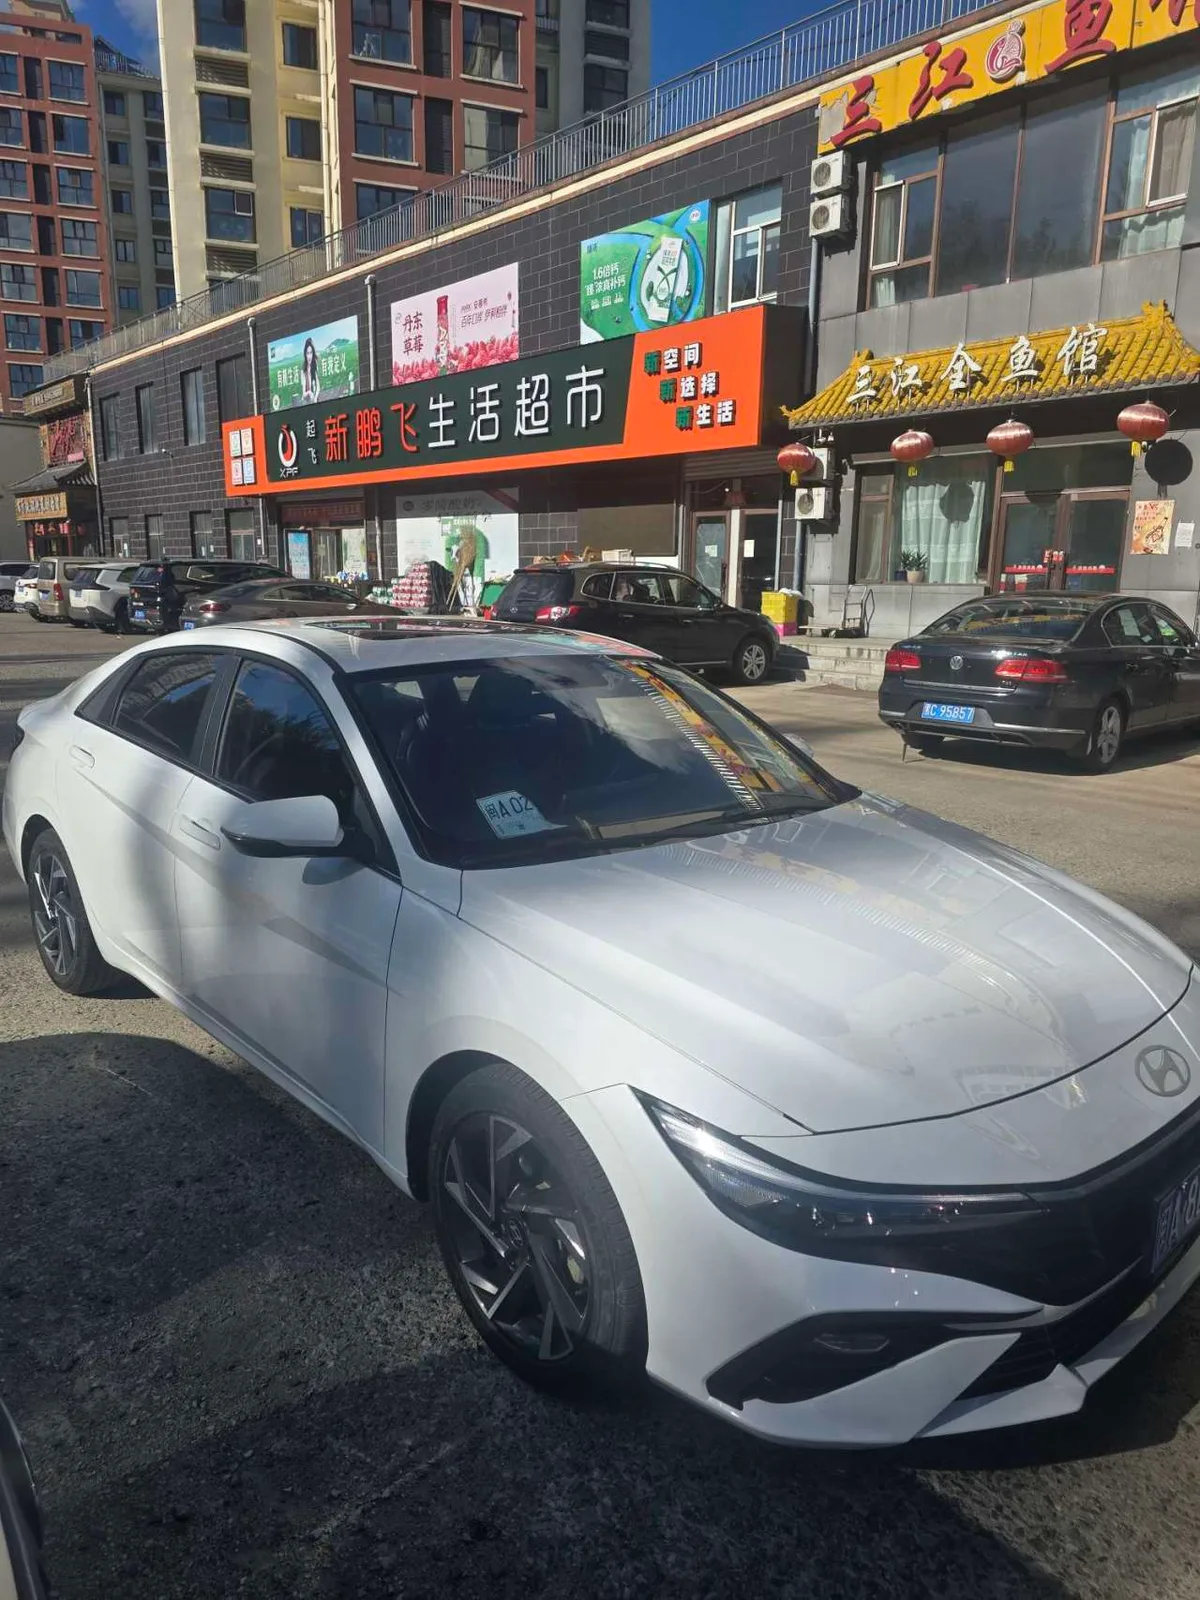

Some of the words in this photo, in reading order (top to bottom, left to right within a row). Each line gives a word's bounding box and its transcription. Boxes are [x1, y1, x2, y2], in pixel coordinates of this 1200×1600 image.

[402, 311, 423, 331] 丹东
[403, 334, 424, 355] 草莓
[644, 342, 702, 377] 新空间
[846, 322, 1109, 404] 三江全鱼馆
[660, 371, 720, 404] 新选择
[324, 364, 605, 462] 新鹏飞生活超市
[676, 400, 734, 431] 新生活
[305, 419, 319, 465] 起飞
[279, 468, 299, 478] XPF
